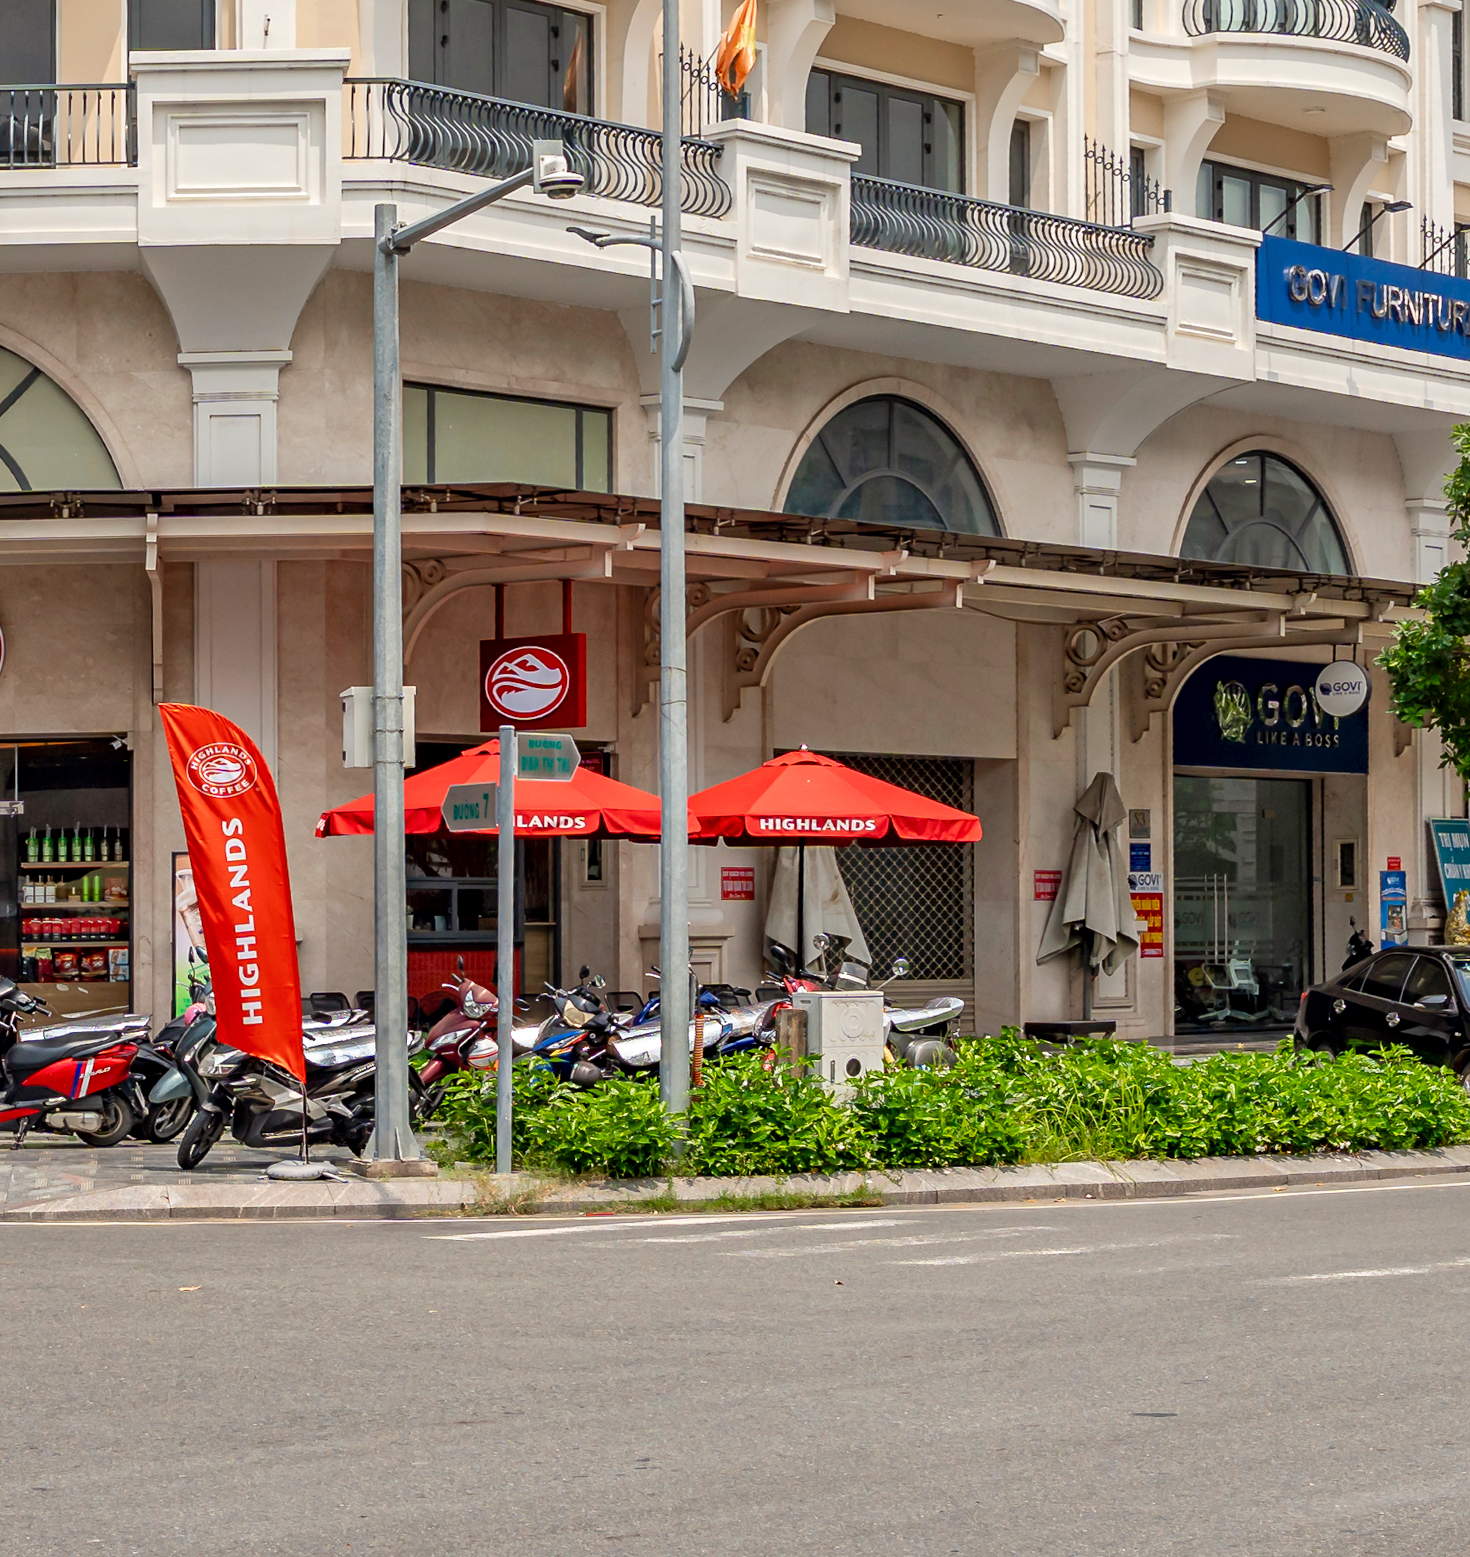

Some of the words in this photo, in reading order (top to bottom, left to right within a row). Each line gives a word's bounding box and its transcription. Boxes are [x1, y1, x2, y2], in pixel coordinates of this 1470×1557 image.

[1288, 264, 1347, 310] GOVI
[1333, 682, 1360, 691] GOVI
[1257, 732, 1287, 745] LIKE
[1293, 733, 1300, 746] A
[1305, 734, 1340, 748] BOSS
[190, 746, 252, 770] HIGHLANDS
[201, 779, 250, 795] COFFEE
[483, 793, 489, 819] 7
[513, 814, 586, 829] LANDS
[760, 818, 876, 831] HIGHLANDS
[1138, 874, 1159, 885] GOVI
[221, 817, 263, 1025] HIGHLANDS
